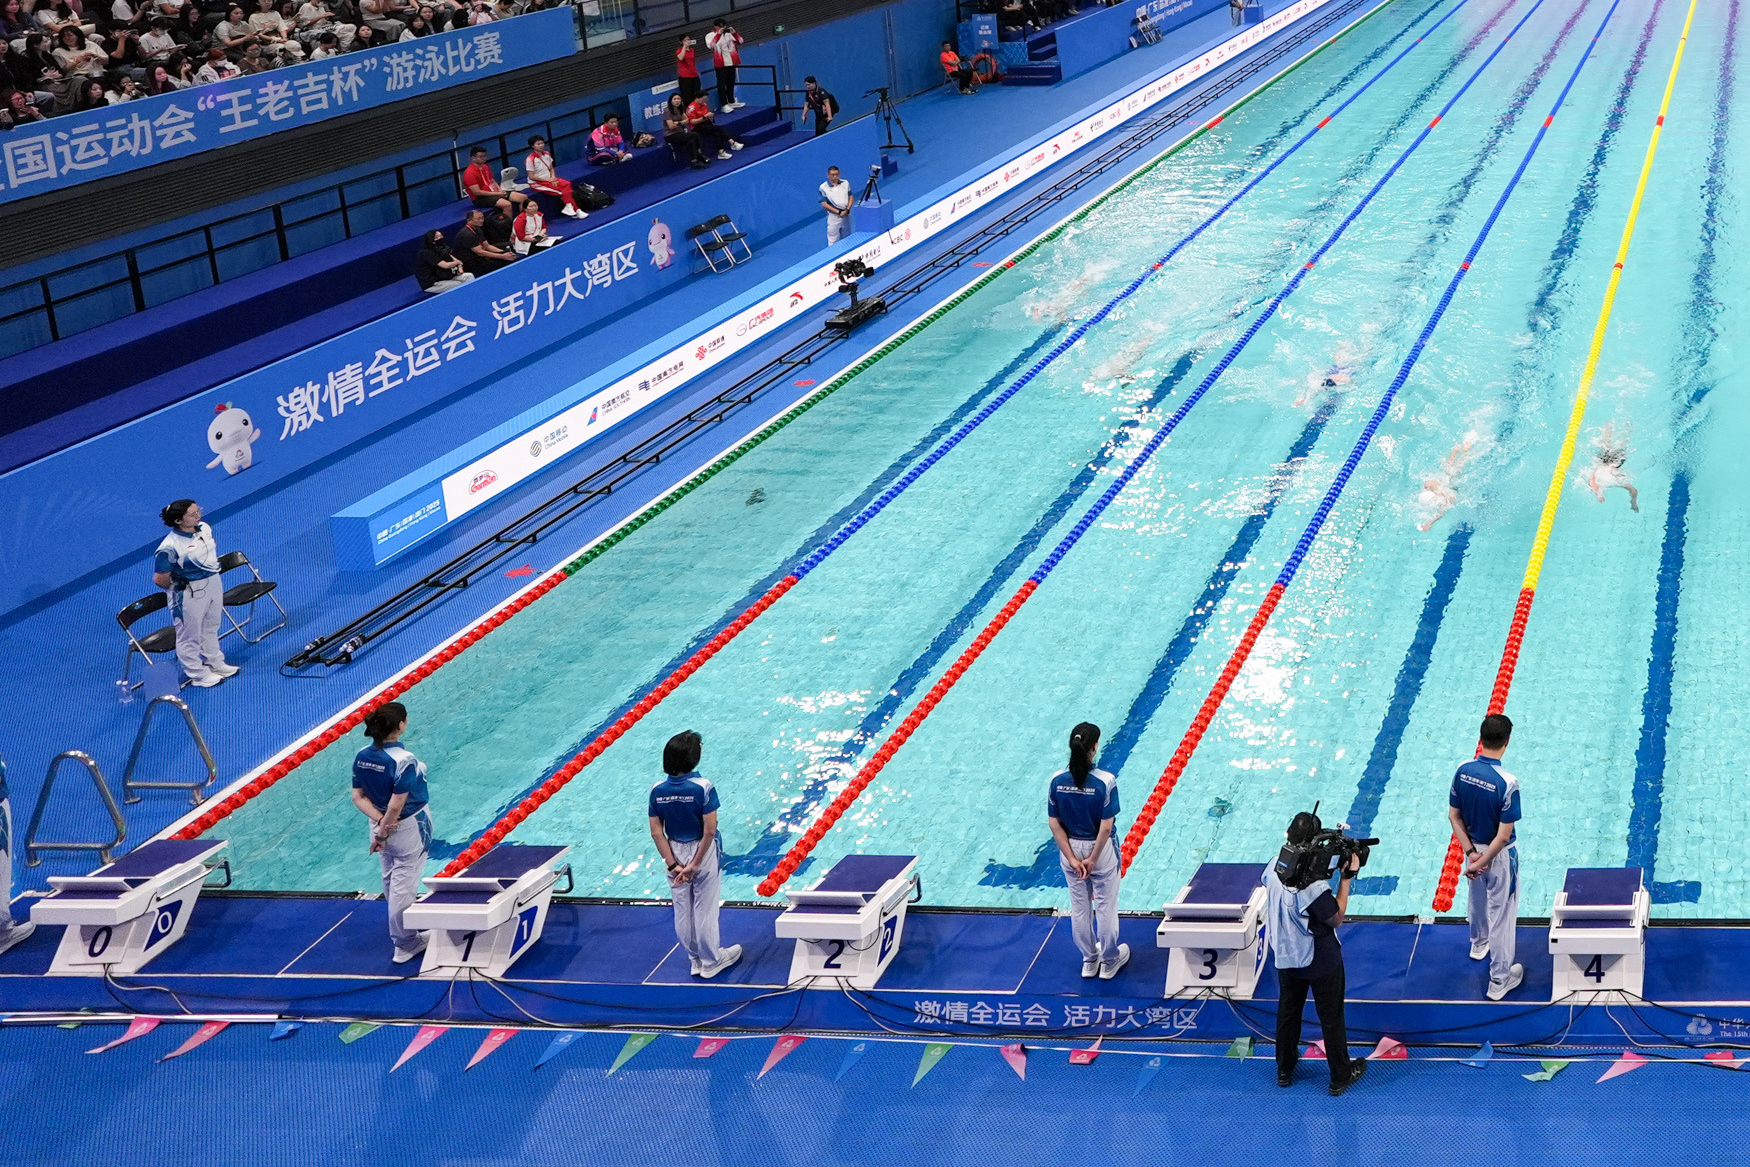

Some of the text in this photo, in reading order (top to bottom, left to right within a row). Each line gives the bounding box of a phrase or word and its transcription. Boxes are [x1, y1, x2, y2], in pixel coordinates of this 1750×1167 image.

[0, 31, 503, 191] 国运动会“王老吉杯”游泳比赛
[277, 240, 638, 441] 激情全运会 活力大湾区
[543, 425, 568, 443] 中国移动
[426, 499, 441, 513] 2025
[522, 919, 528, 940] 1
[883, 927, 892, 948] 2
[461, 930, 476, 962] 1
[824, 939, 844, 968] 2
[1257, 938, 1264, 961] 3
[1199, 949, 1218, 980] 3
[1583, 954, 1605, 983] 4
[913, 1000, 1198, 1029] 激情全运会 活力大湾区
